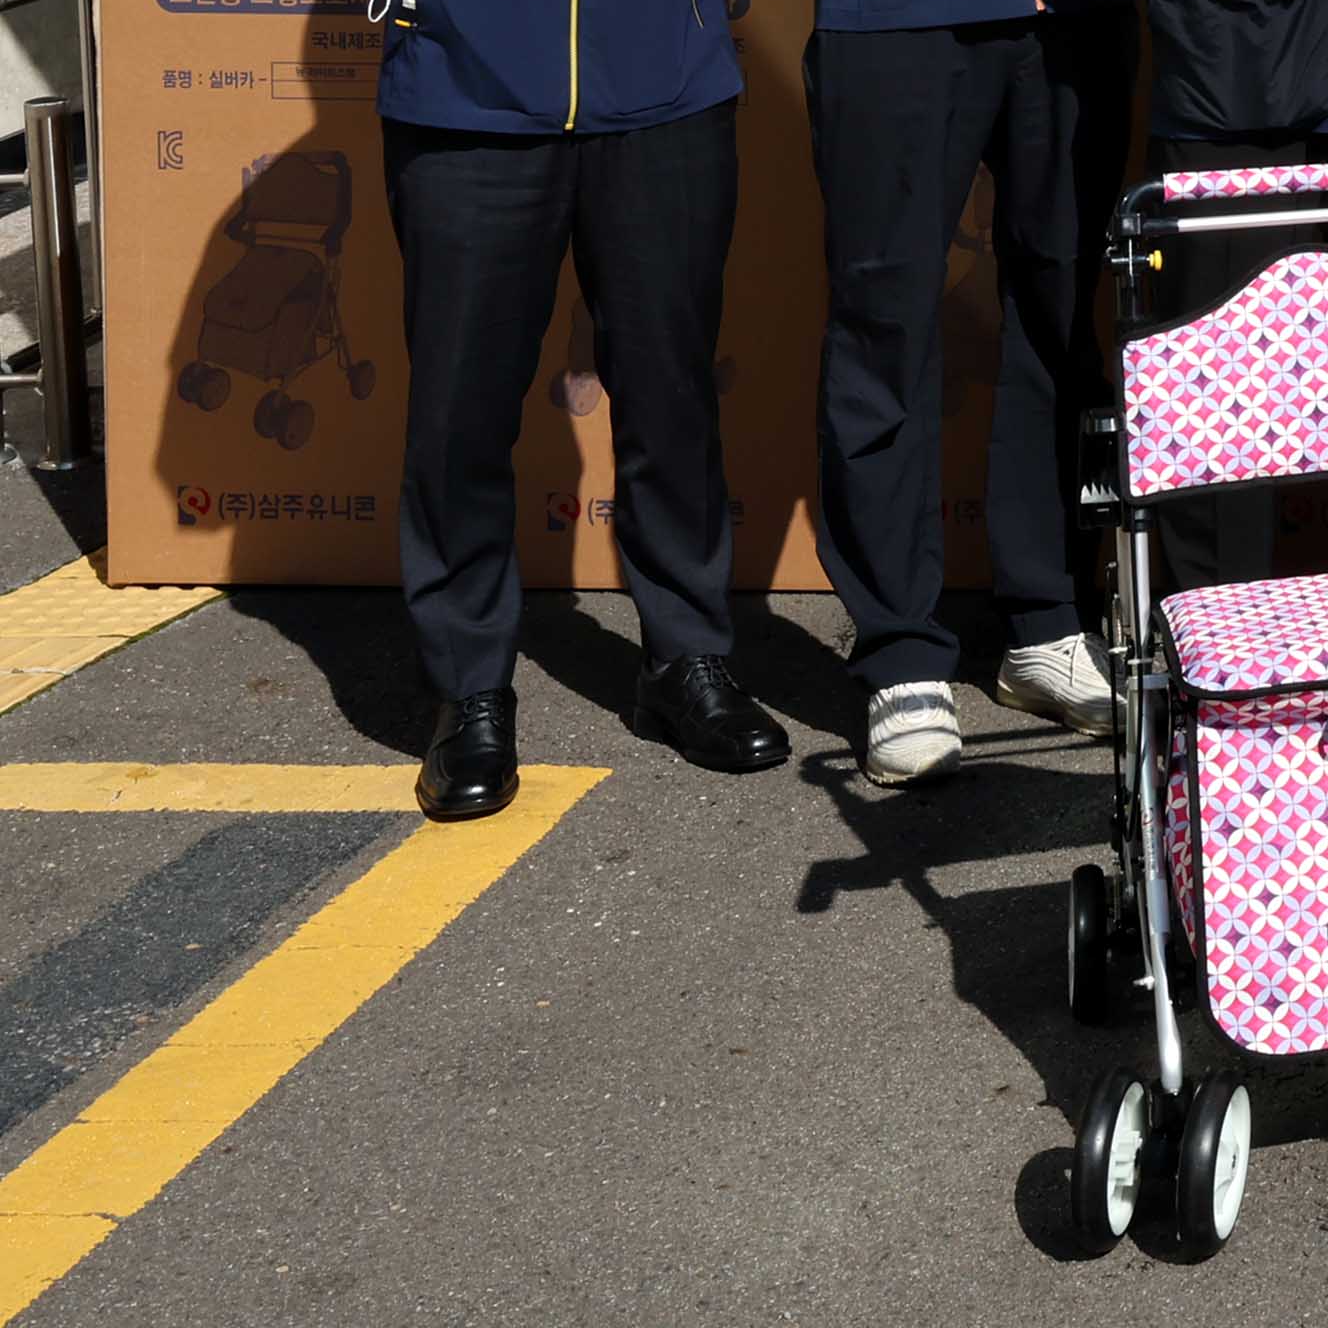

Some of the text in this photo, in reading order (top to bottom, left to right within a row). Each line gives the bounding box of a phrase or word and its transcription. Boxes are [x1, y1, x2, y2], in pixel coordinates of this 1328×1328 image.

[311, 32, 384, 49] 국내제조
[162, 70, 192, 88] 품명
[209, 70, 254, 88] 실버카
[218, 492, 375, 521] (주)삼주유니콘
